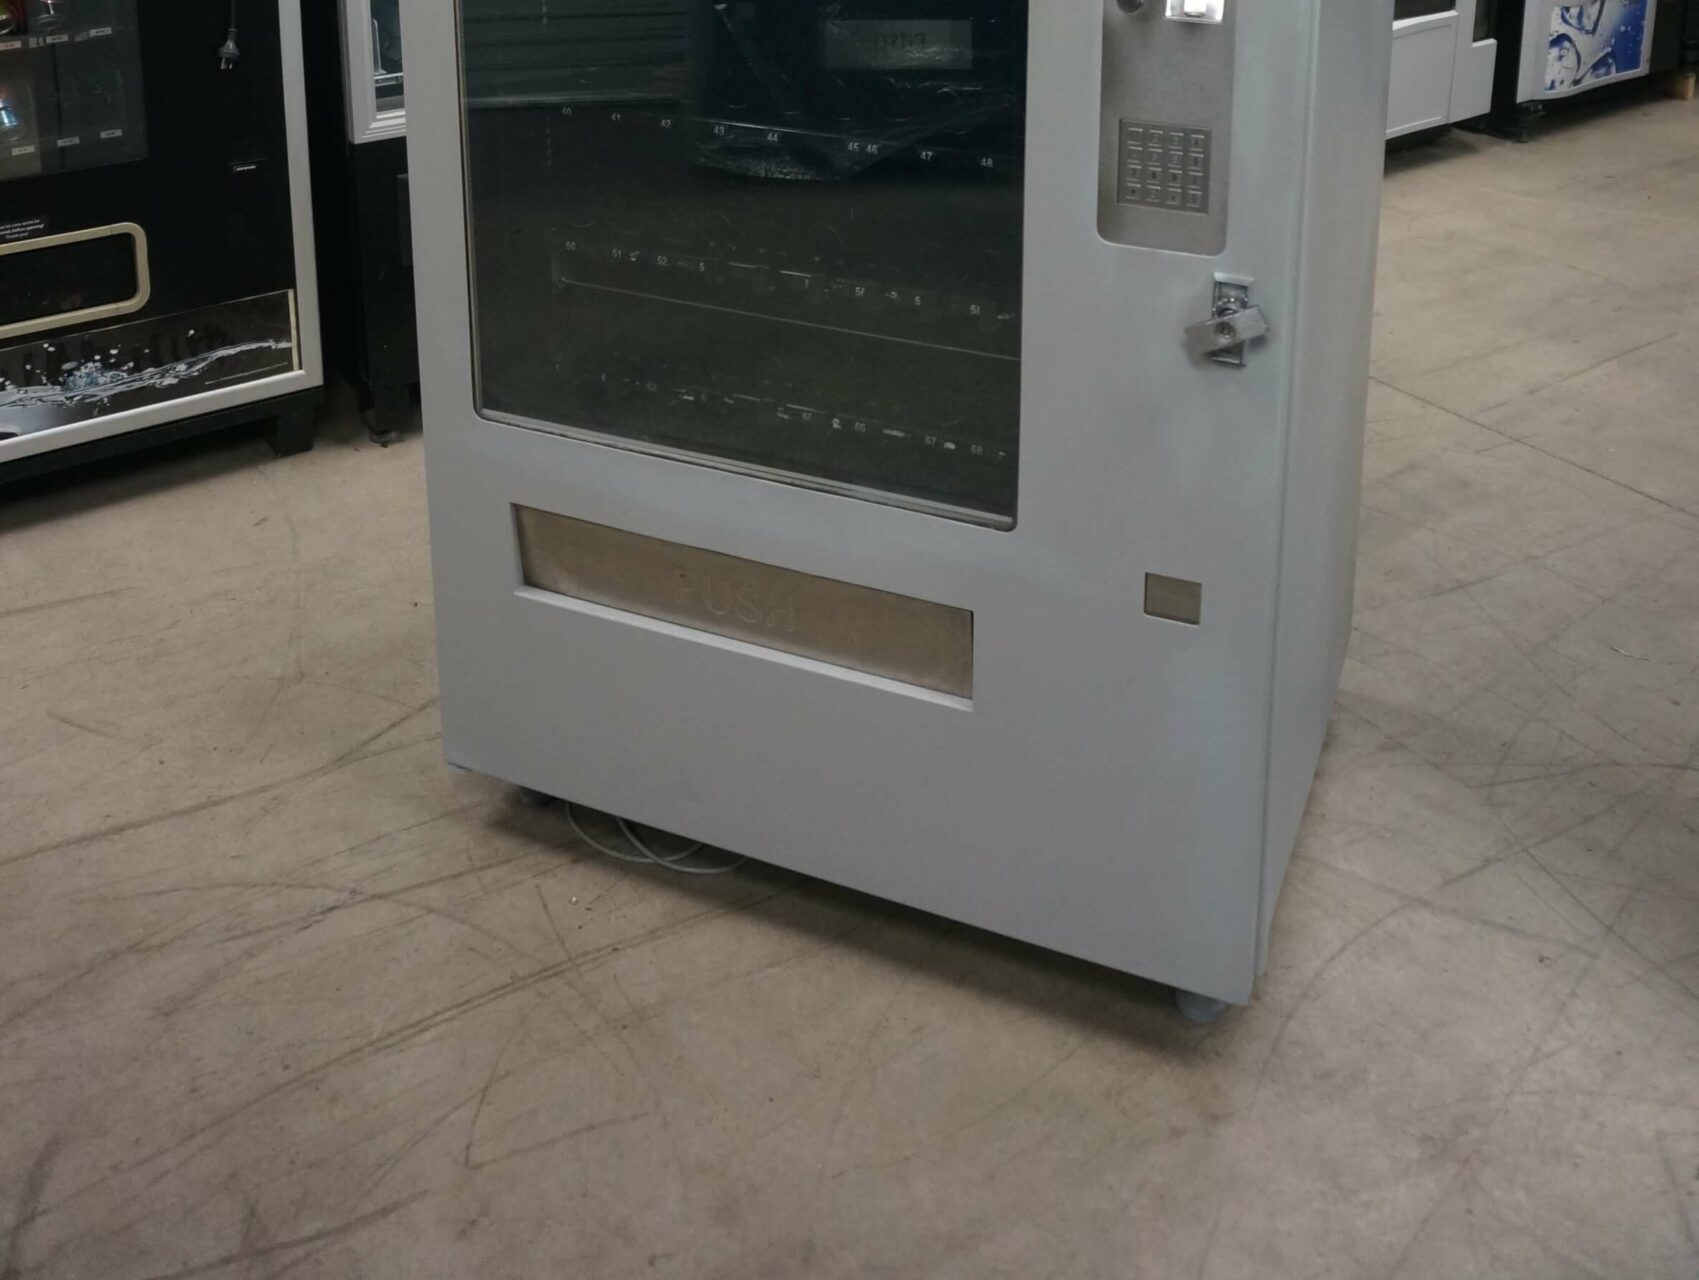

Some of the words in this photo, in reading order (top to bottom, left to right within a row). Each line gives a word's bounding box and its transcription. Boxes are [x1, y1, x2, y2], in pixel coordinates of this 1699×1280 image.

[660, 119, 672, 129] 42
[713, 125, 725, 137] 43
[767, 132, 779, 143] 44
[847, 141, 860, 153] 45
[866, 144, 879, 155] 46
[920, 150, 933, 162] 47
[980, 156, 994, 168] 48
[612, 248, 622, 259] 51
[675, 568, 796, 632] PUSH
